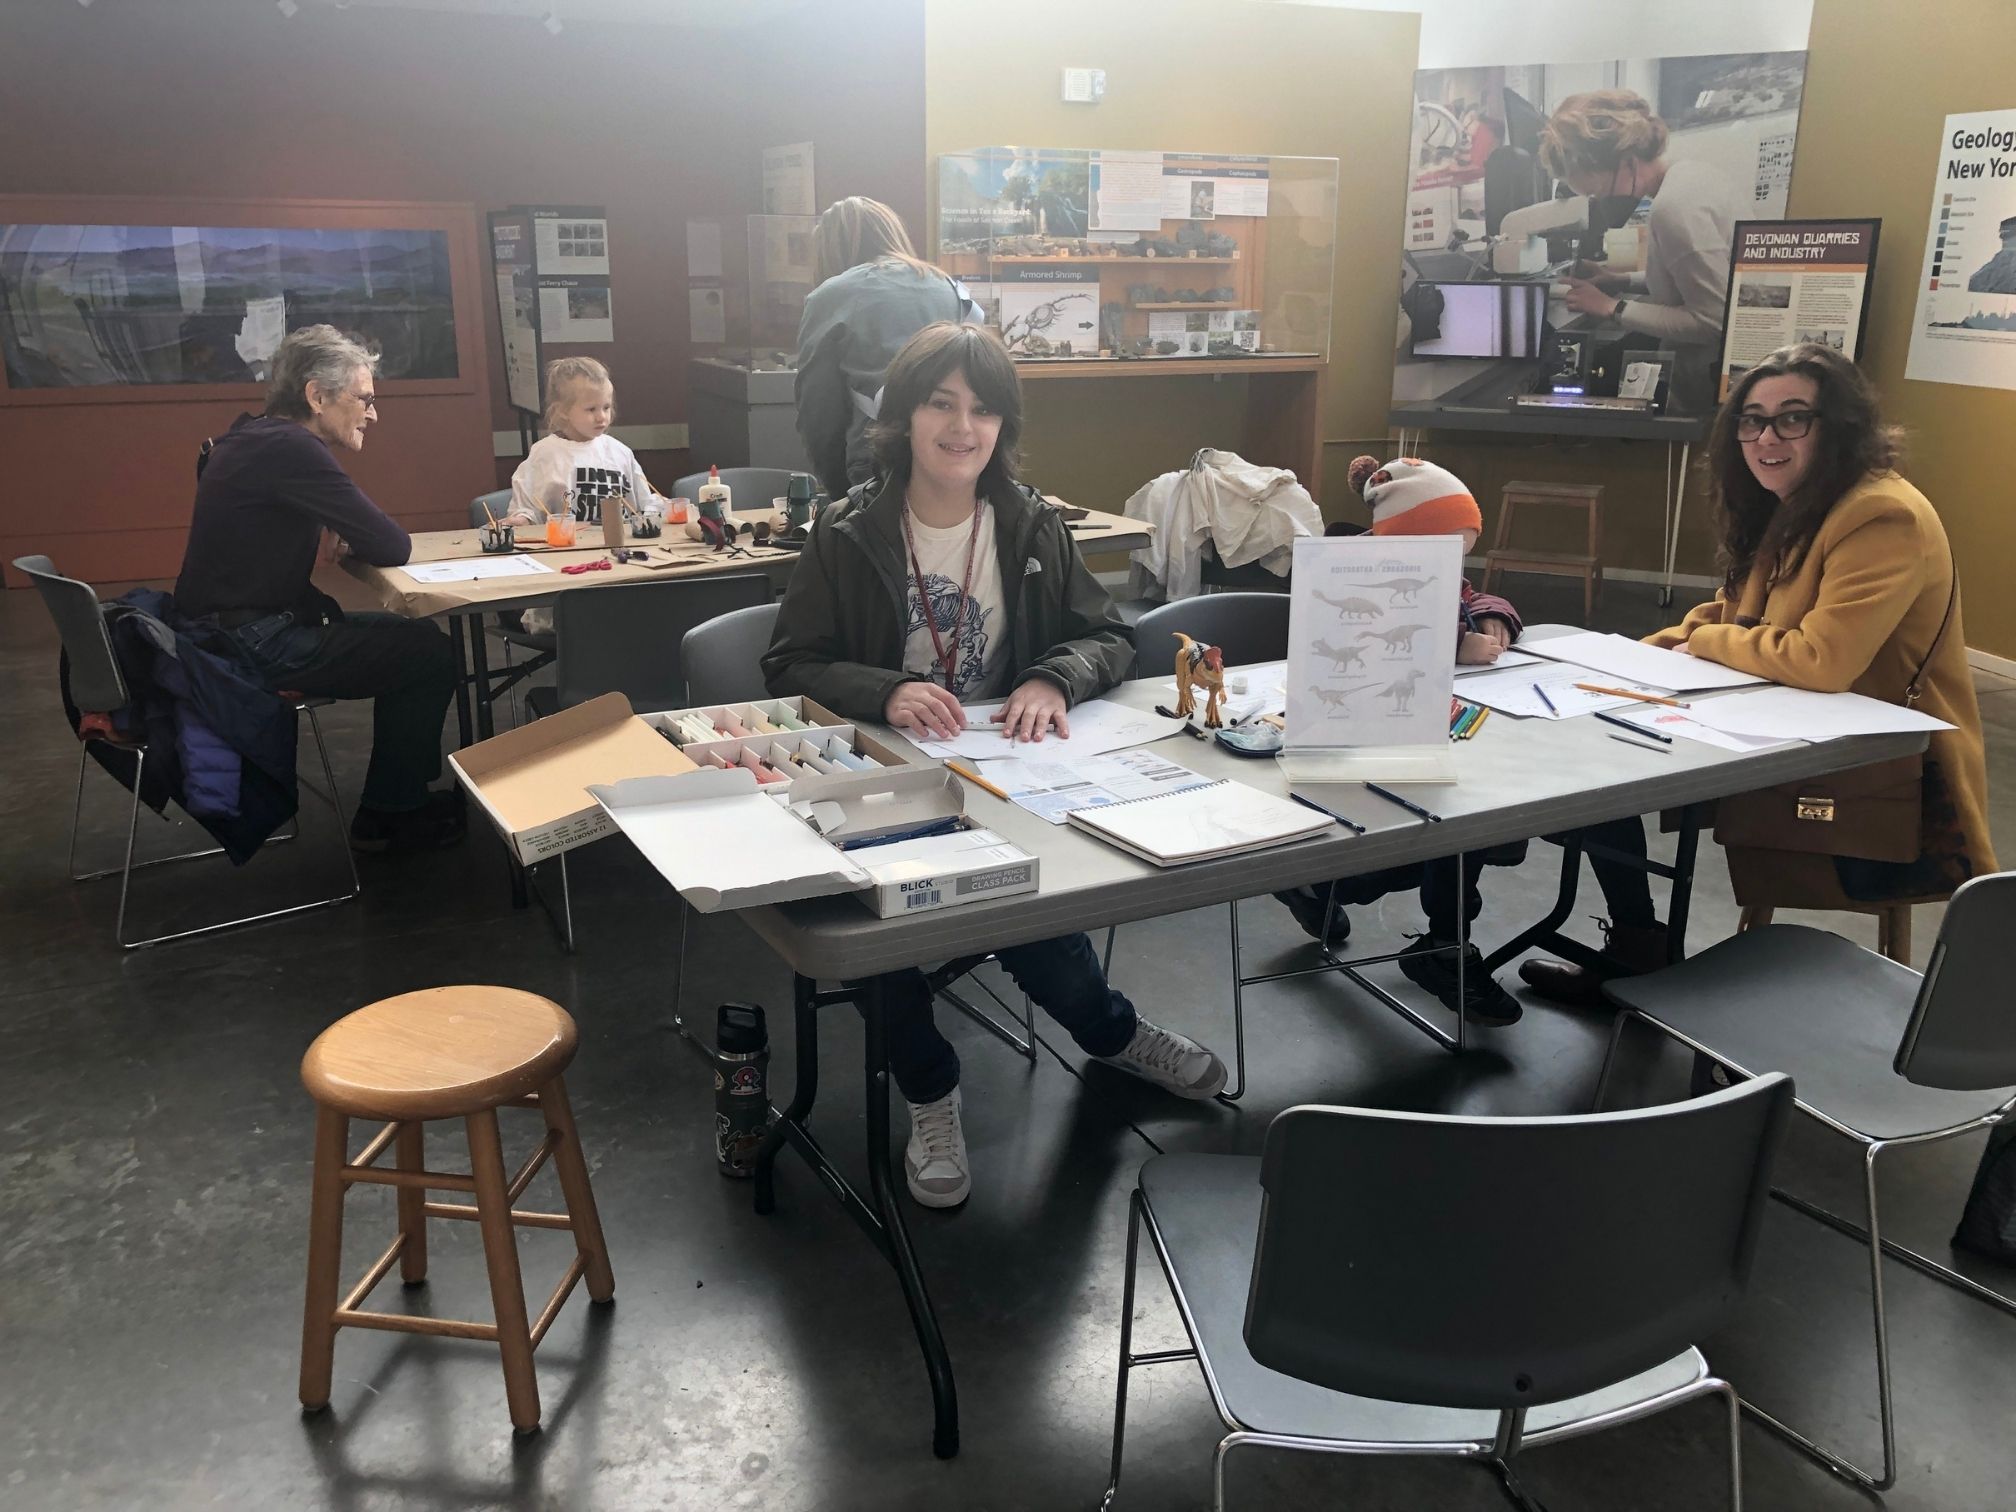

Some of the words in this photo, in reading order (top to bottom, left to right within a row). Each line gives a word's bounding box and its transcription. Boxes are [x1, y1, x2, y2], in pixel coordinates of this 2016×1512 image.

[1947, 159, 1986, 179] New
[1745, 233, 1799, 245] DEVONIAN
[1803, 232, 1860, 245] QUARRIES
[1743, 247, 1766, 258] AND
[1770, 247, 1826, 258] INDUSTRY
[1020, 270, 1054, 279] Armored
[1055, 270, 1082, 280] Shrimp
[565, 828, 598, 844] ASSORTED
[537, 840, 564, 853] COLORS
[971, 870, 1002, 882] DRAWING
[1002, 867, 1026, 878] PENCIL
[900, 878, 934, 892] BLICK
[971, 878, 1000, 890] CLASS
[1002, 874, 1026, 884] PACK
